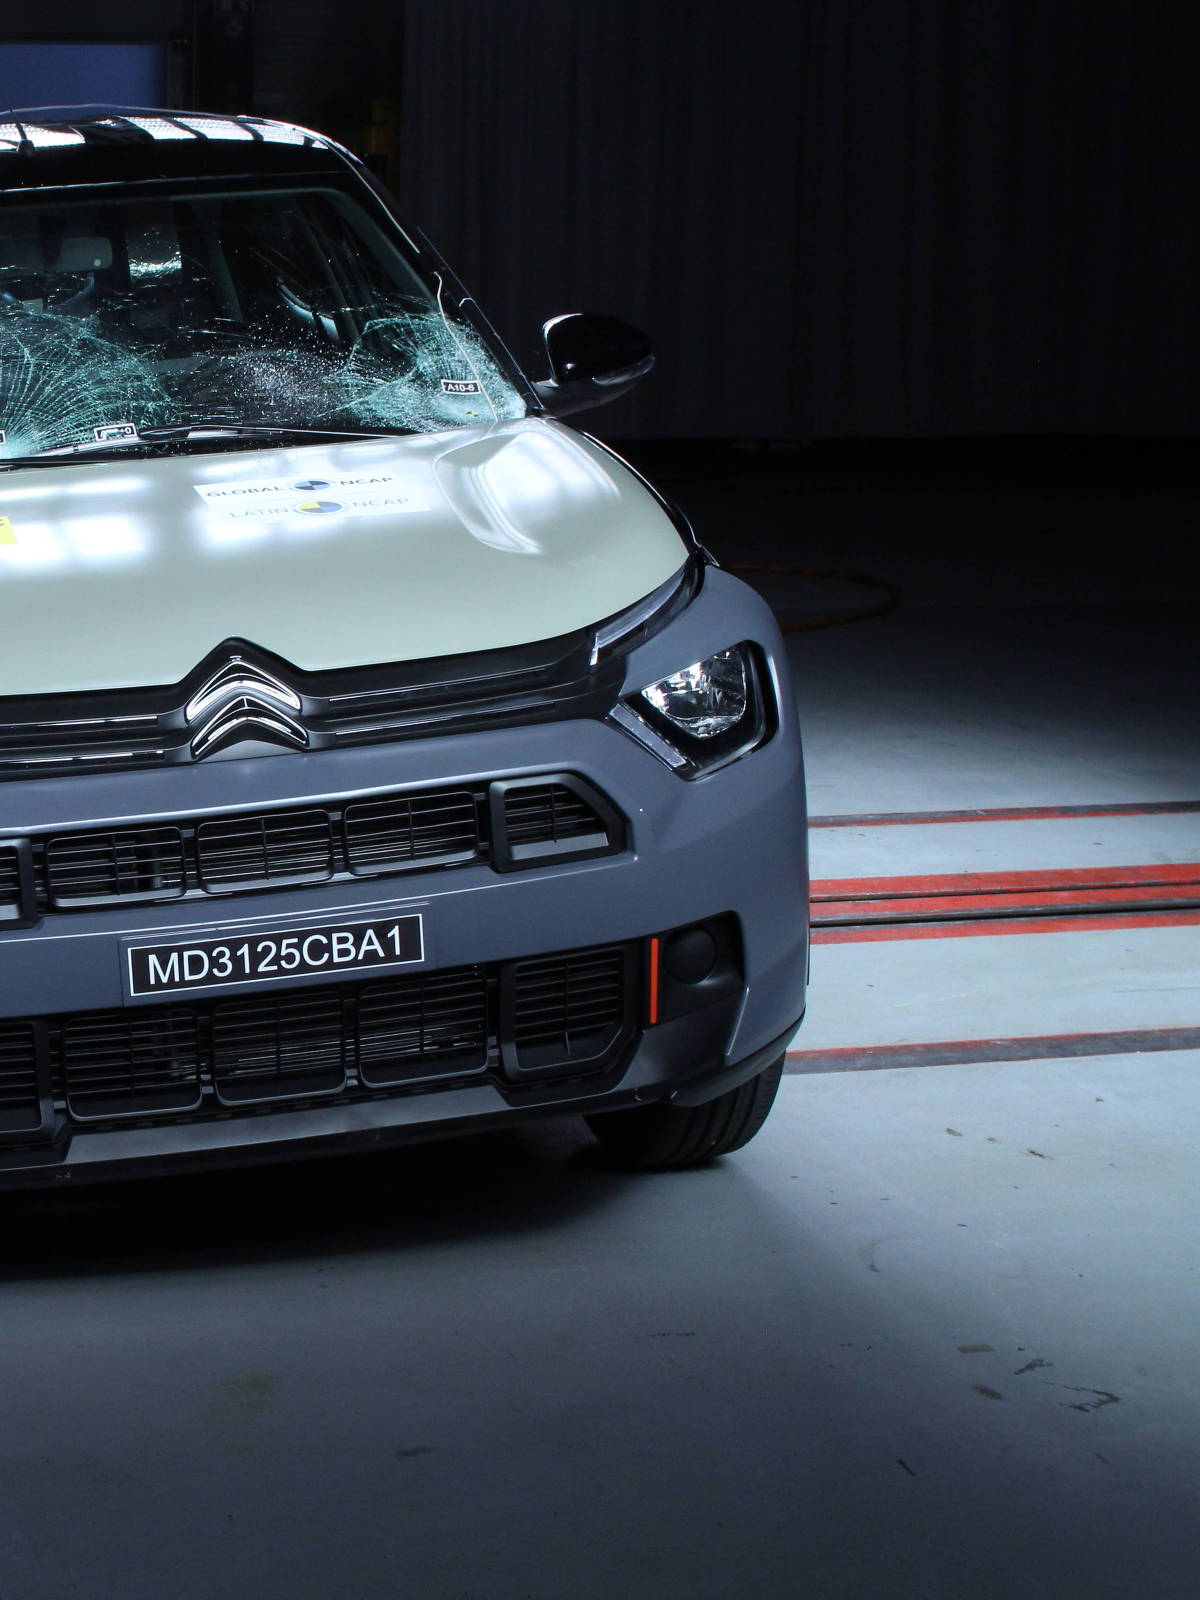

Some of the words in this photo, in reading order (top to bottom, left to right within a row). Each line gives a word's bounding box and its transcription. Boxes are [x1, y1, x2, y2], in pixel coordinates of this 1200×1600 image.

[447, 384, 475, 392] A10-6
[206, 487, 285, 498] GLOBAL
[340, 477, 393, 486] NCAP
[229, 507, 289, 518] LATIN
[352, 498, 409, 508] NCAP
[148, 925, 402, 985] MD3125CBA1
